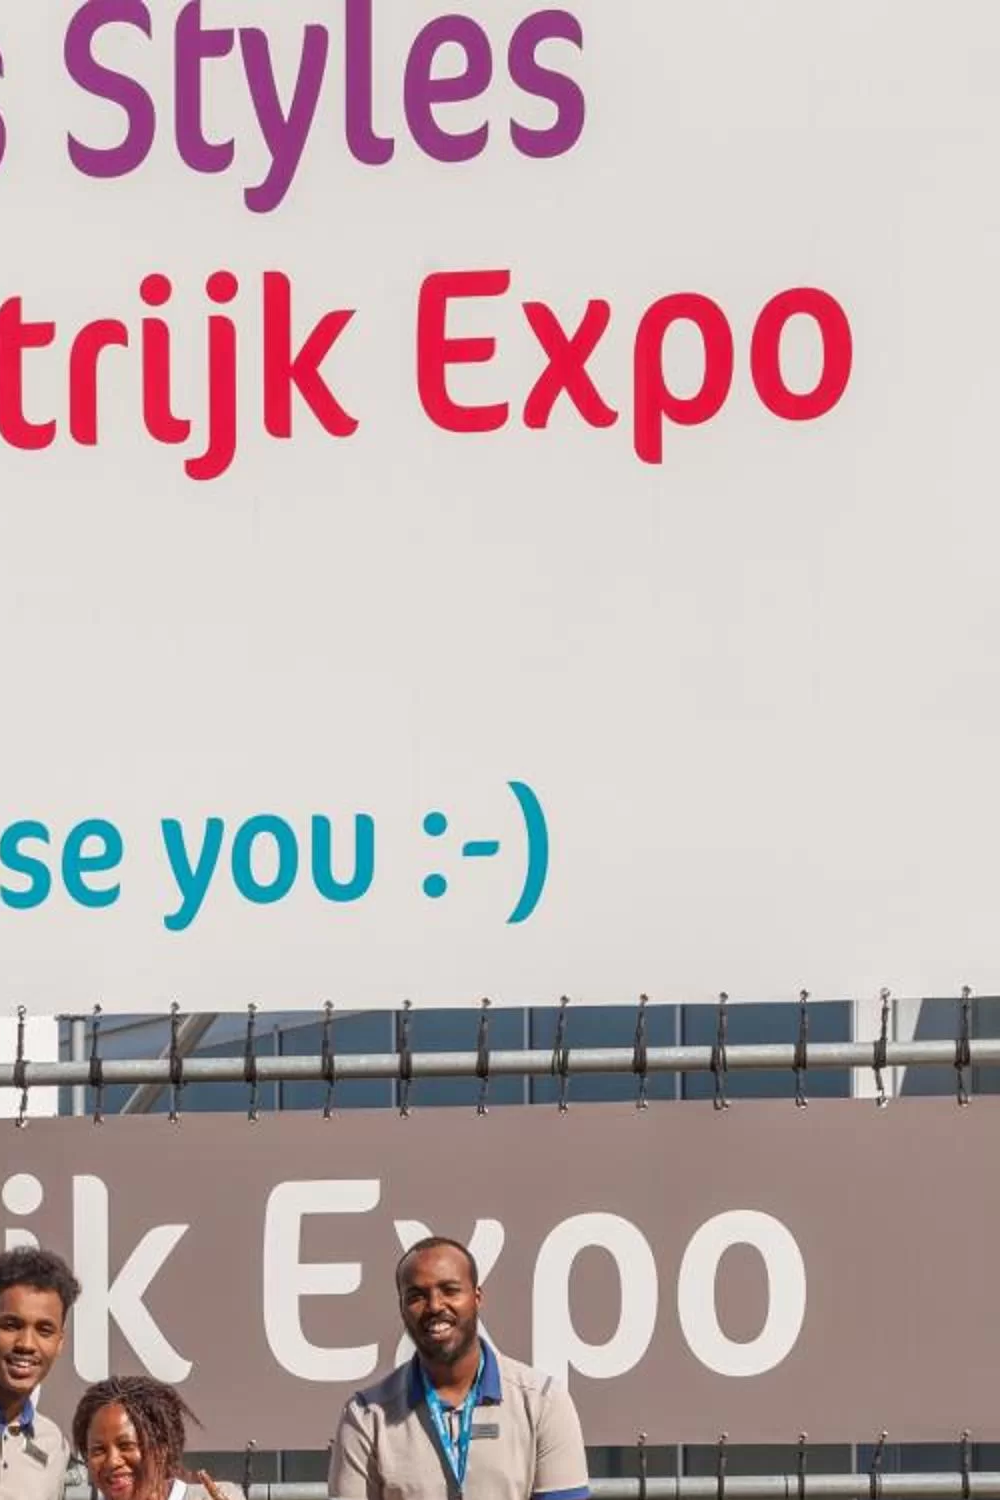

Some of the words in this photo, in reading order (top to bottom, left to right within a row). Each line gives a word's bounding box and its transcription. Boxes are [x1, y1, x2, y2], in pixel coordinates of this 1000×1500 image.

[64, 0, 586, 214] Styles
[415, 269, 854, 466] Expo
[160, 813, 377, 932] you
